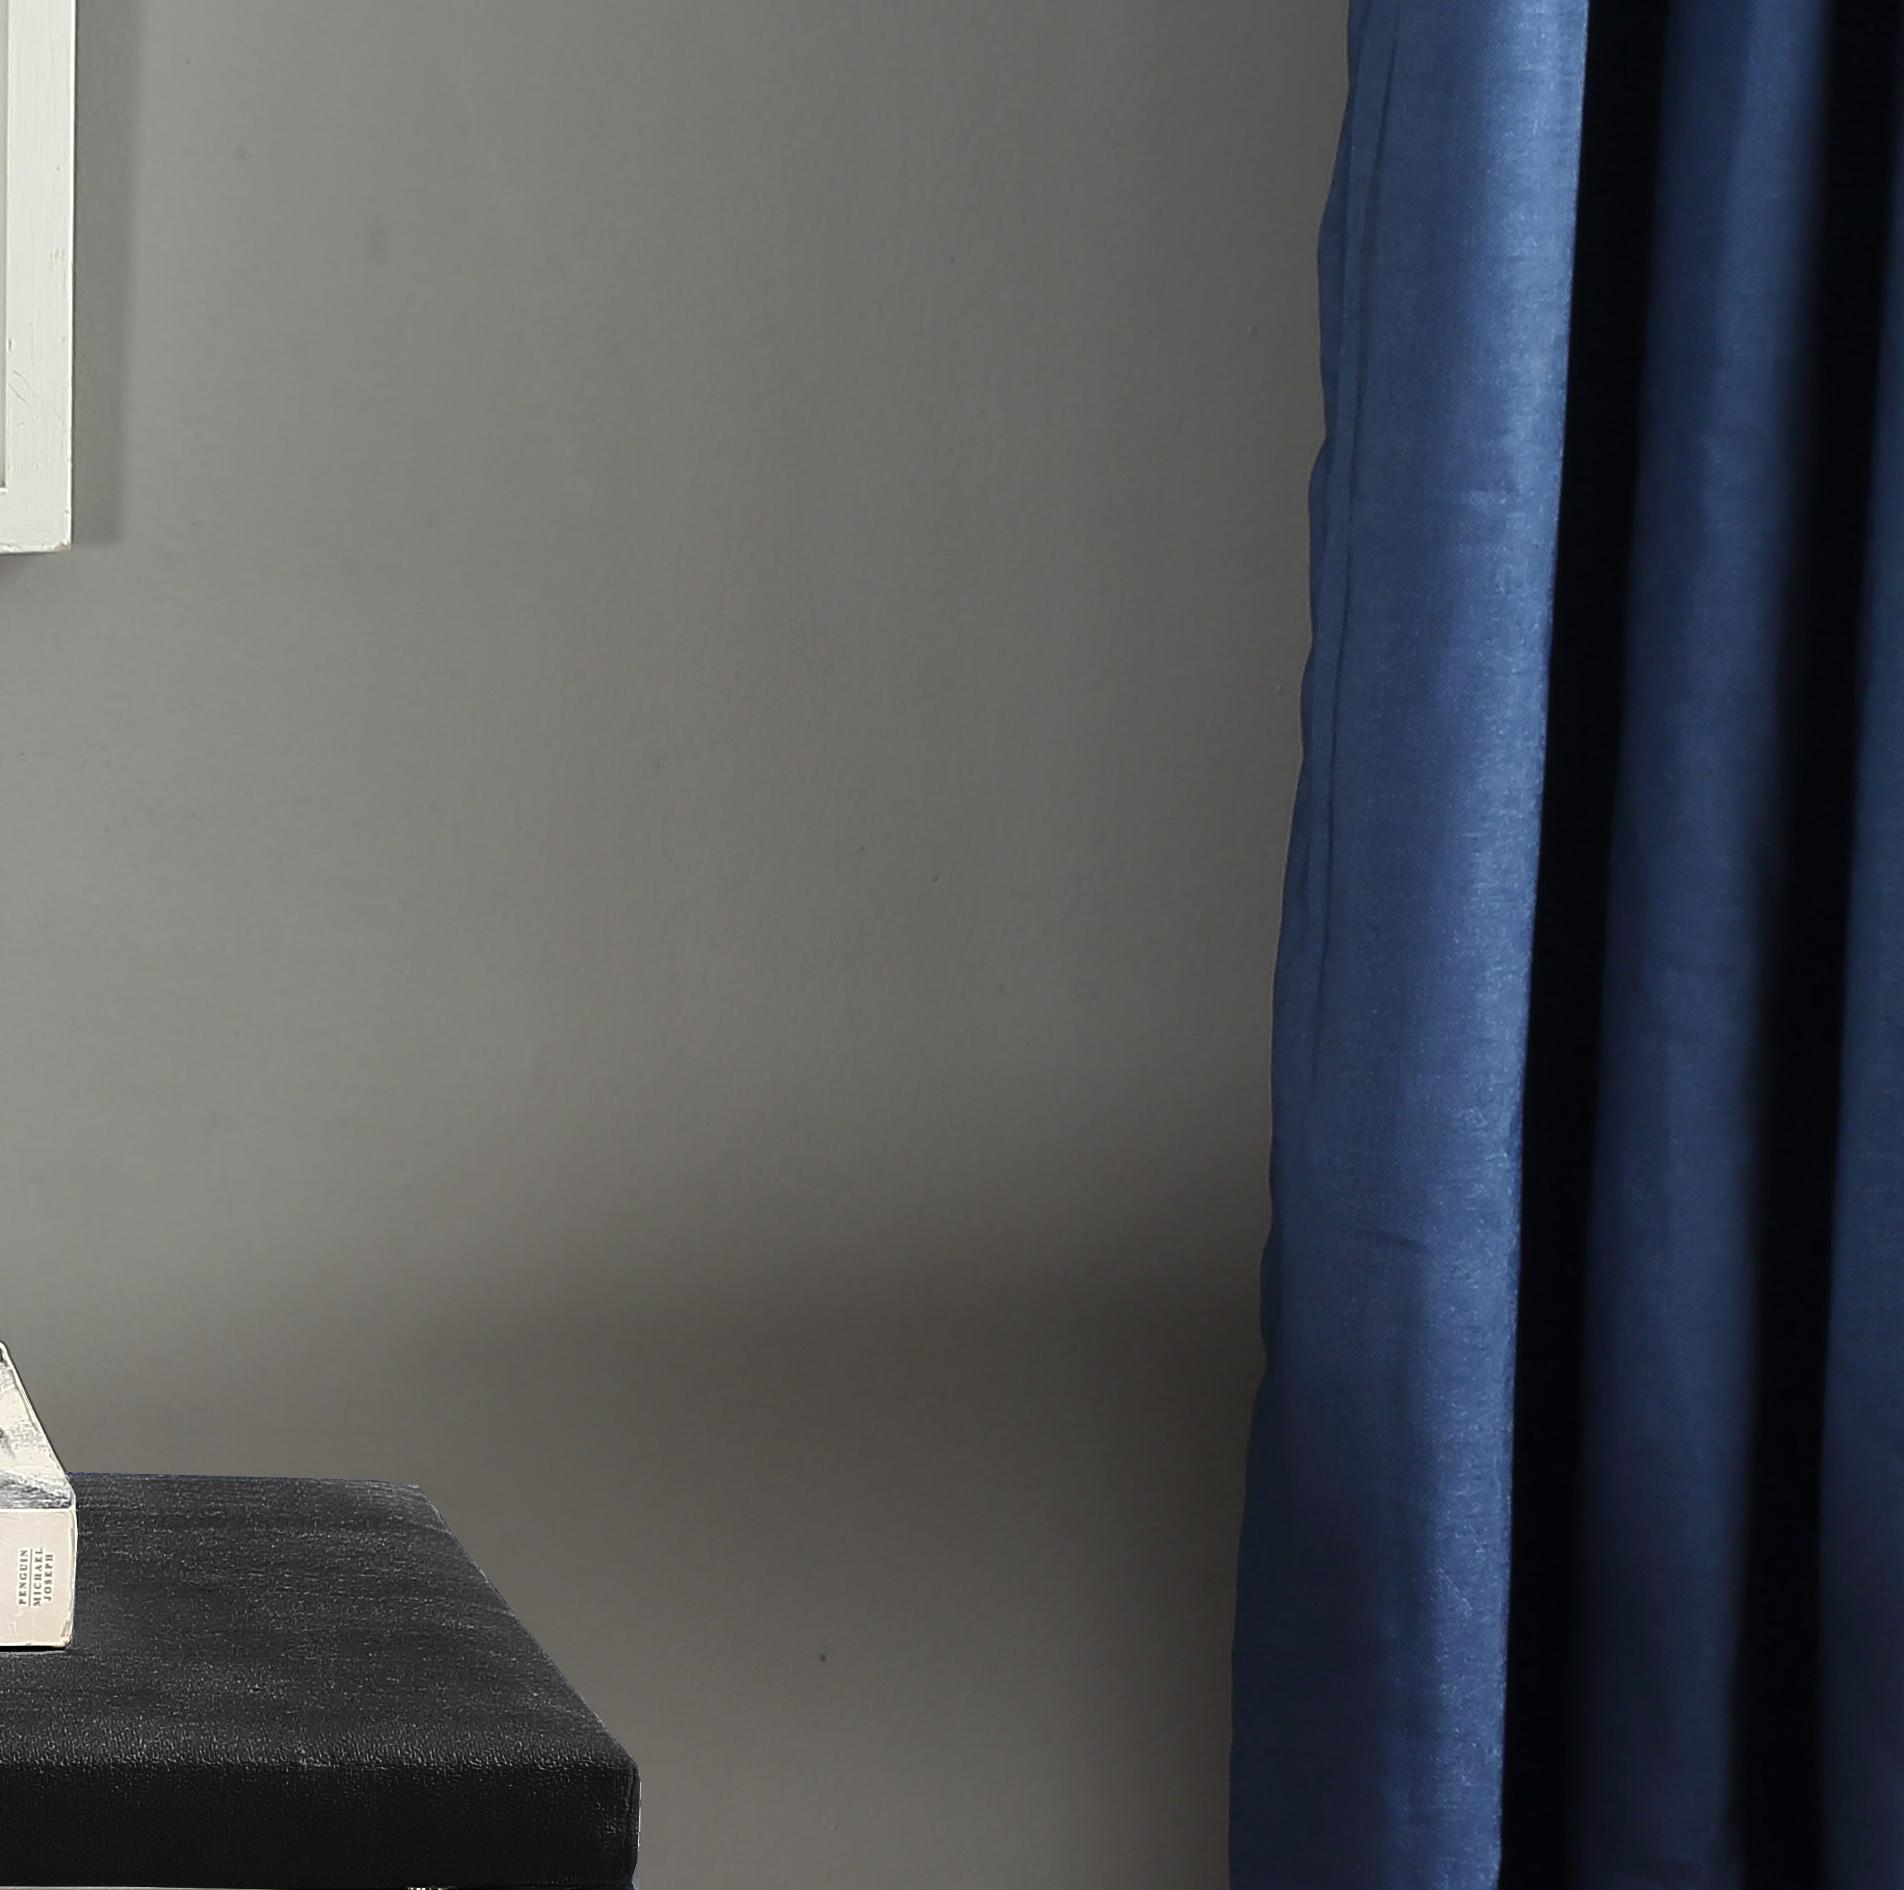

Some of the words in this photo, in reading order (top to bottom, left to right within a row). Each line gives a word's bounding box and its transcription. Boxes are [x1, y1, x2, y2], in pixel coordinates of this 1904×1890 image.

[18, 1550, 28, 1605] PENGUIN
[33, 1547, 43, 1606] MICHAEL
[43, 1554, 53, 1601] JOSEPH
